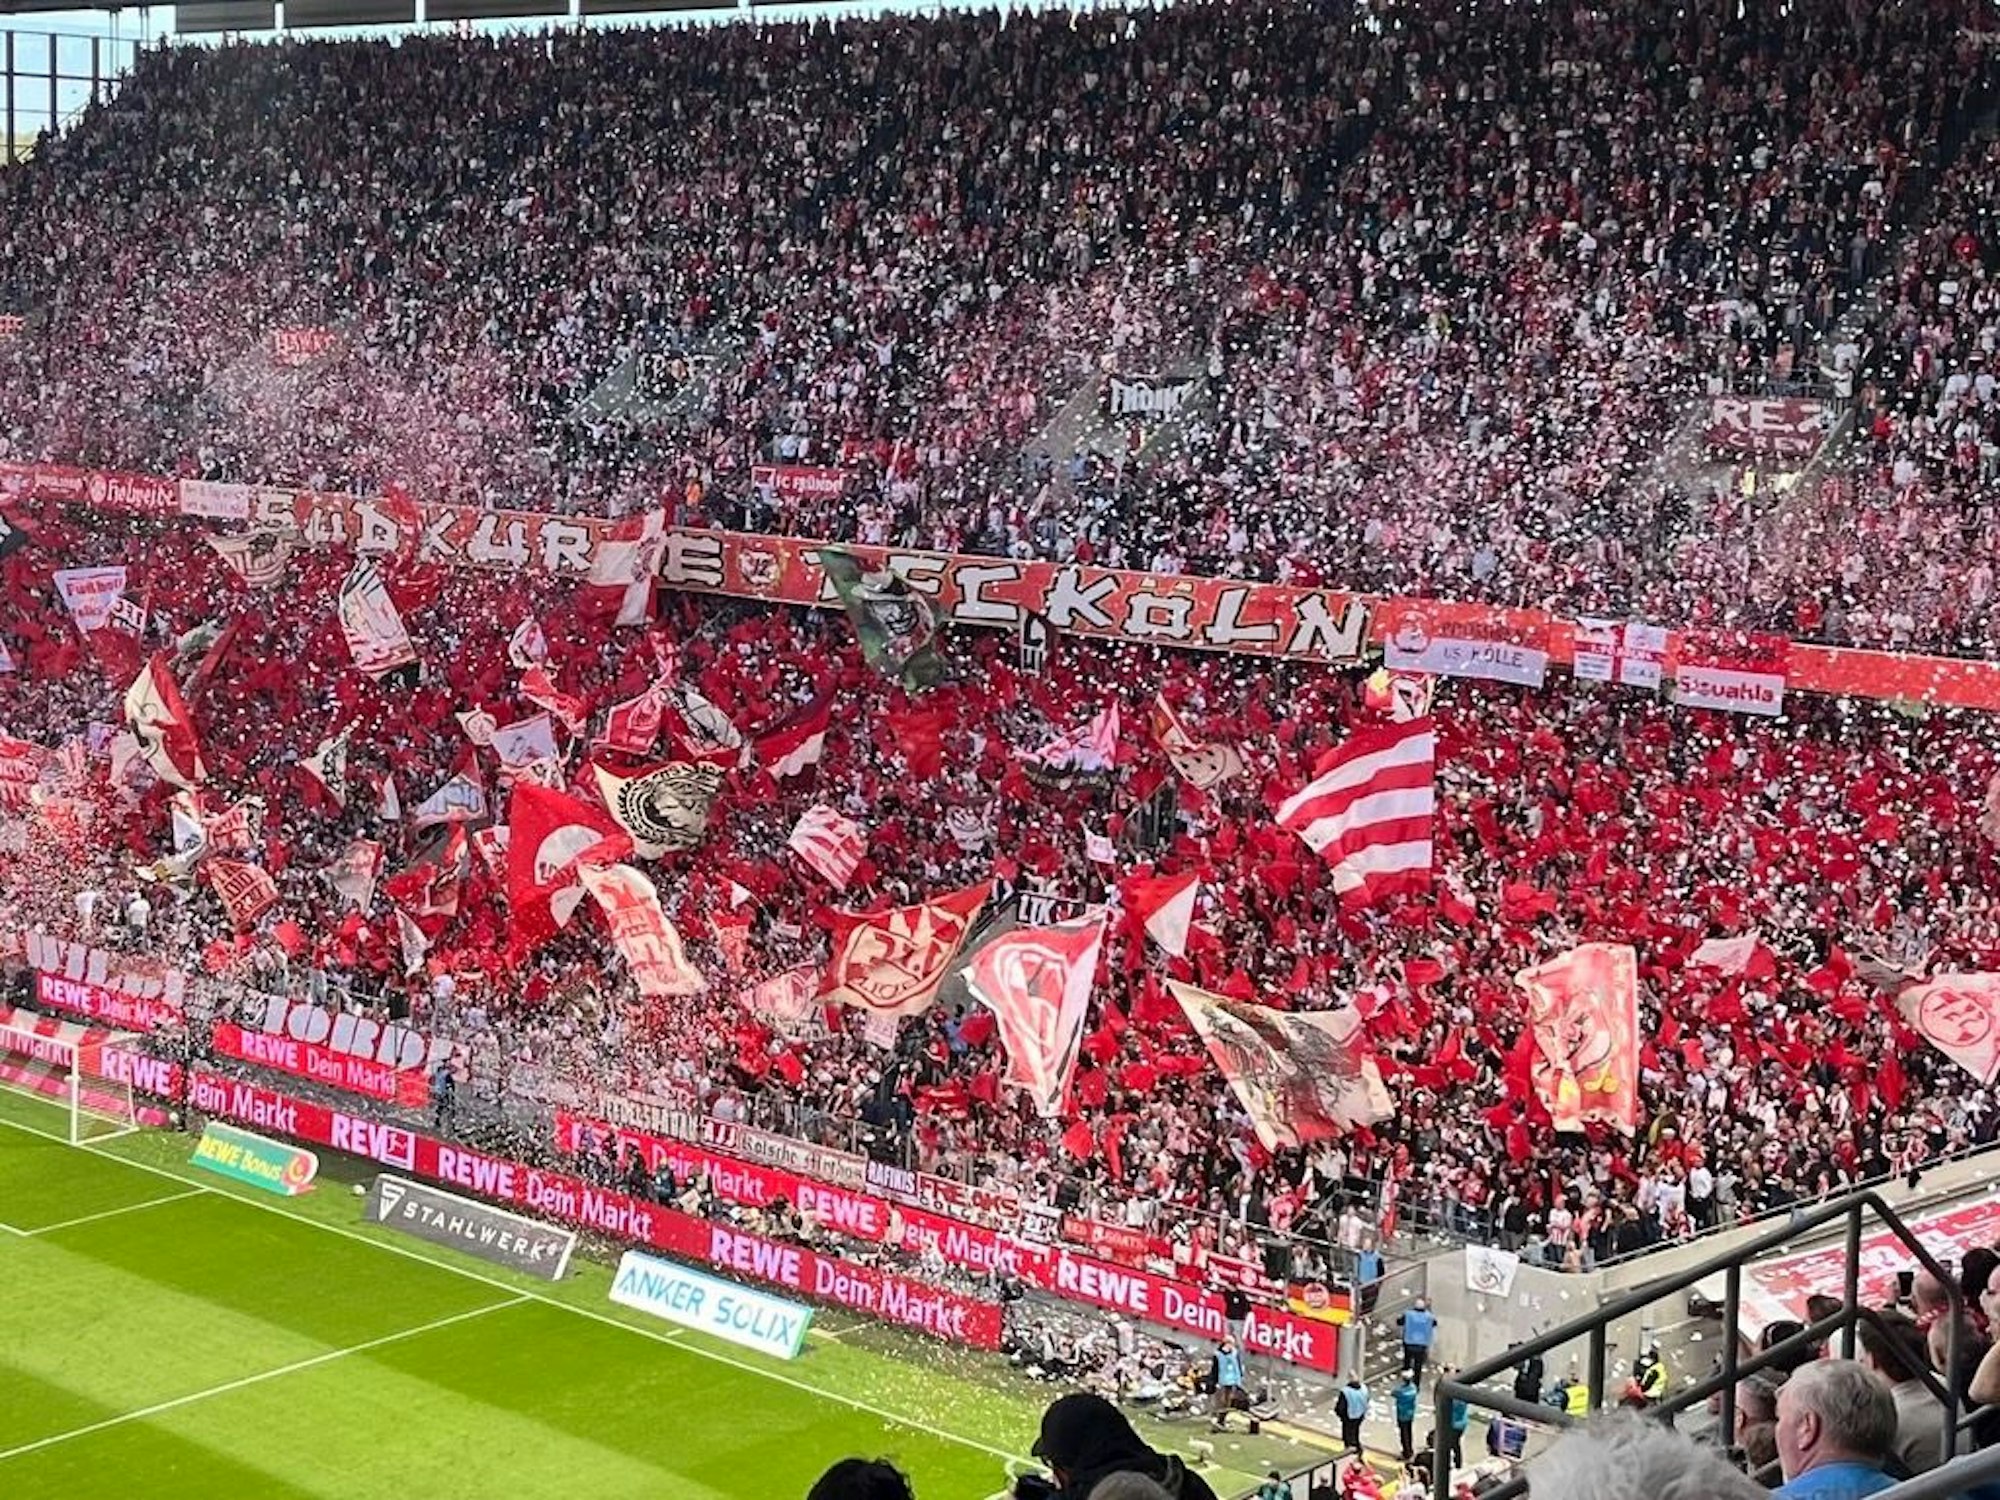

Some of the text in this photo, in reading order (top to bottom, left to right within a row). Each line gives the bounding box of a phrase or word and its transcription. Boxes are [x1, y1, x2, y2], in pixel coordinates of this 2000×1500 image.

[1727, 431, 1815, 450] CREW
[253, 489, 725, 590] SÜDKURE
[1042, 565, 1370, 660] KÖLN
[41, 976, 92, 1013] REWE
[101, 1045, 172, 1096] REWE
[231, 1083, 298, 1135] Markt
[241, 1030, 298, 1068] REWE
[307, 1047, 343, 1080] Dein
[199, 1135, 284, 1181] REWE Bonus
[438, 1146, 653, 1241] REWE Dein Markt
[700, 1158, 765, 1203] Markt
[403, 1201, 550, 1262] STAHLWERK
[797, 1184, 1020, 1275] REWE ein Markt
[617, 1266, 797, 1347] ANKER SOLIX
[709, 1227, 968, 1340] REWE Dein Markt
[1057, 1252, 1149, 1312] REWE
[1163, 1286, 1223, 1334] Dein
